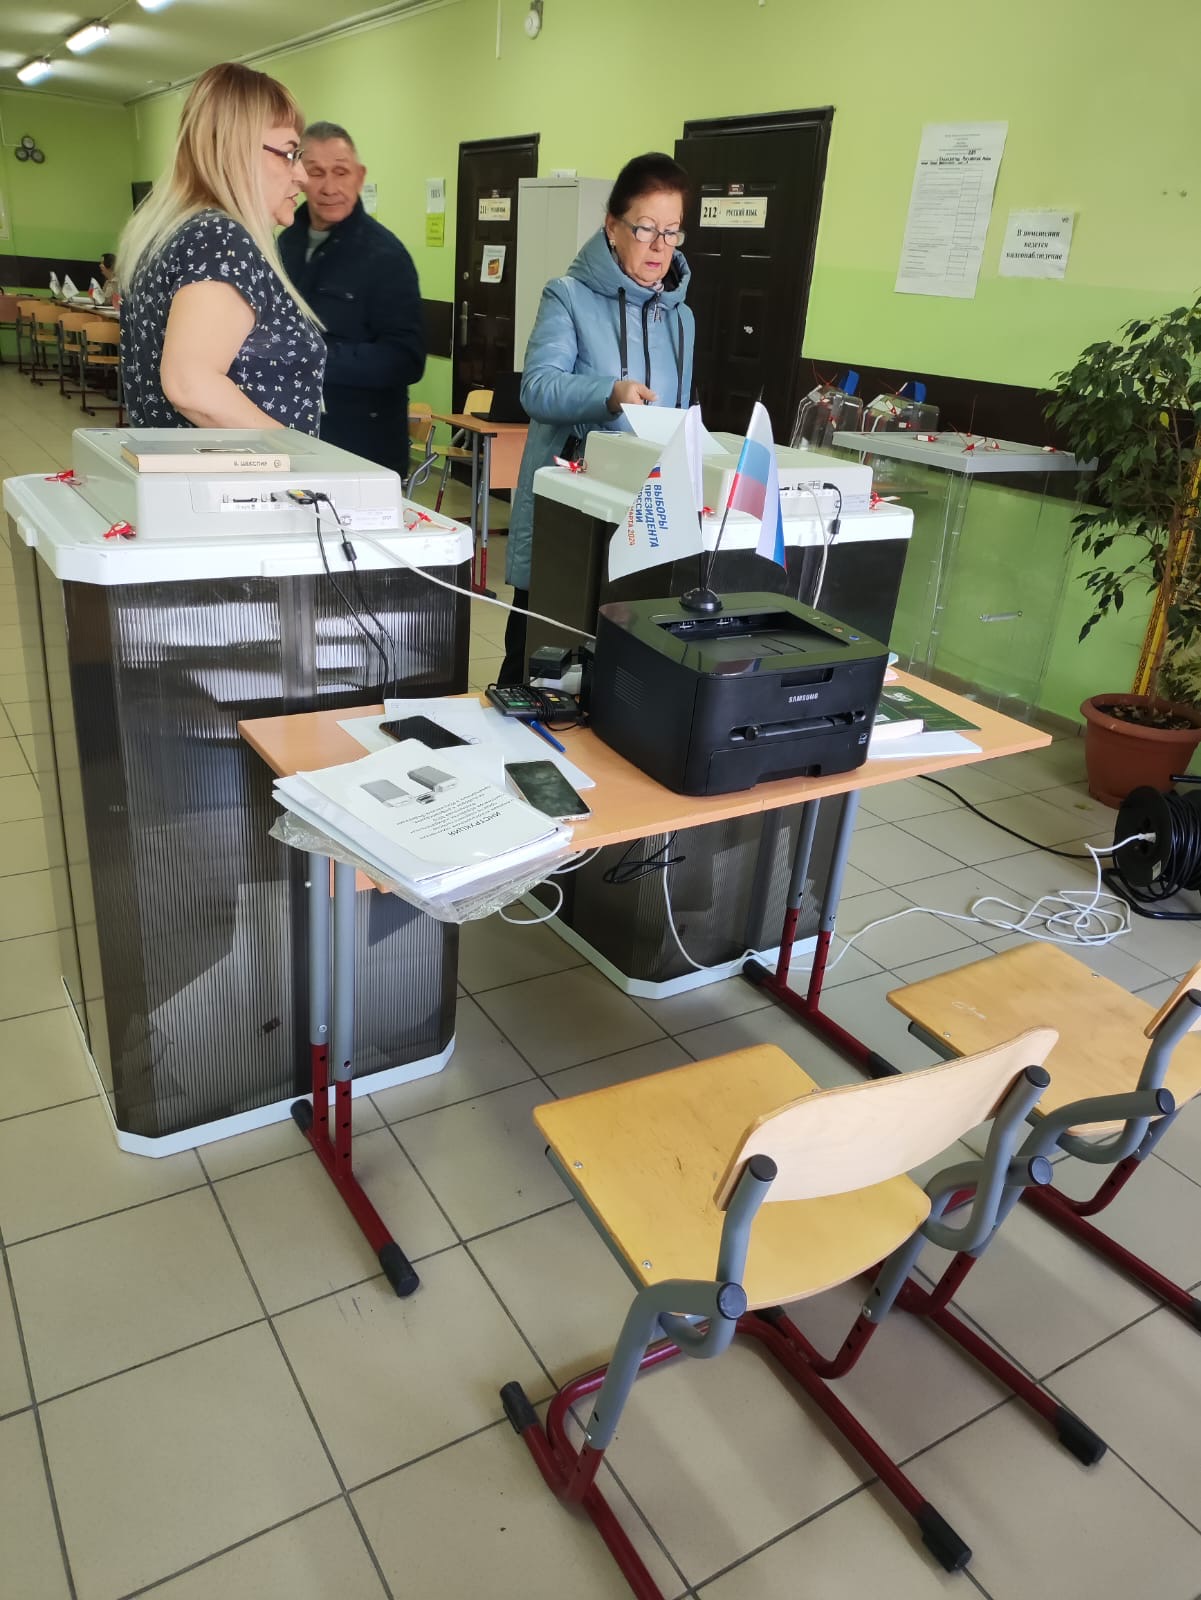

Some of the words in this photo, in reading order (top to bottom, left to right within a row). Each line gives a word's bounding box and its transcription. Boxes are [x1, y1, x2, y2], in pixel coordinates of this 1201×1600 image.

[703, 206, 717, 218] 212
[635, 486, 644, 523] ОССИИ
[644, 484, 660, 548] ПРЕЗИДЕНТА
[653, 484, 669, 530] ВЫБОРЫ
[788, 692, 819, 703] SAMSUNG
[447, 811, 502, 837] ИНСТРУКЦИЯ
